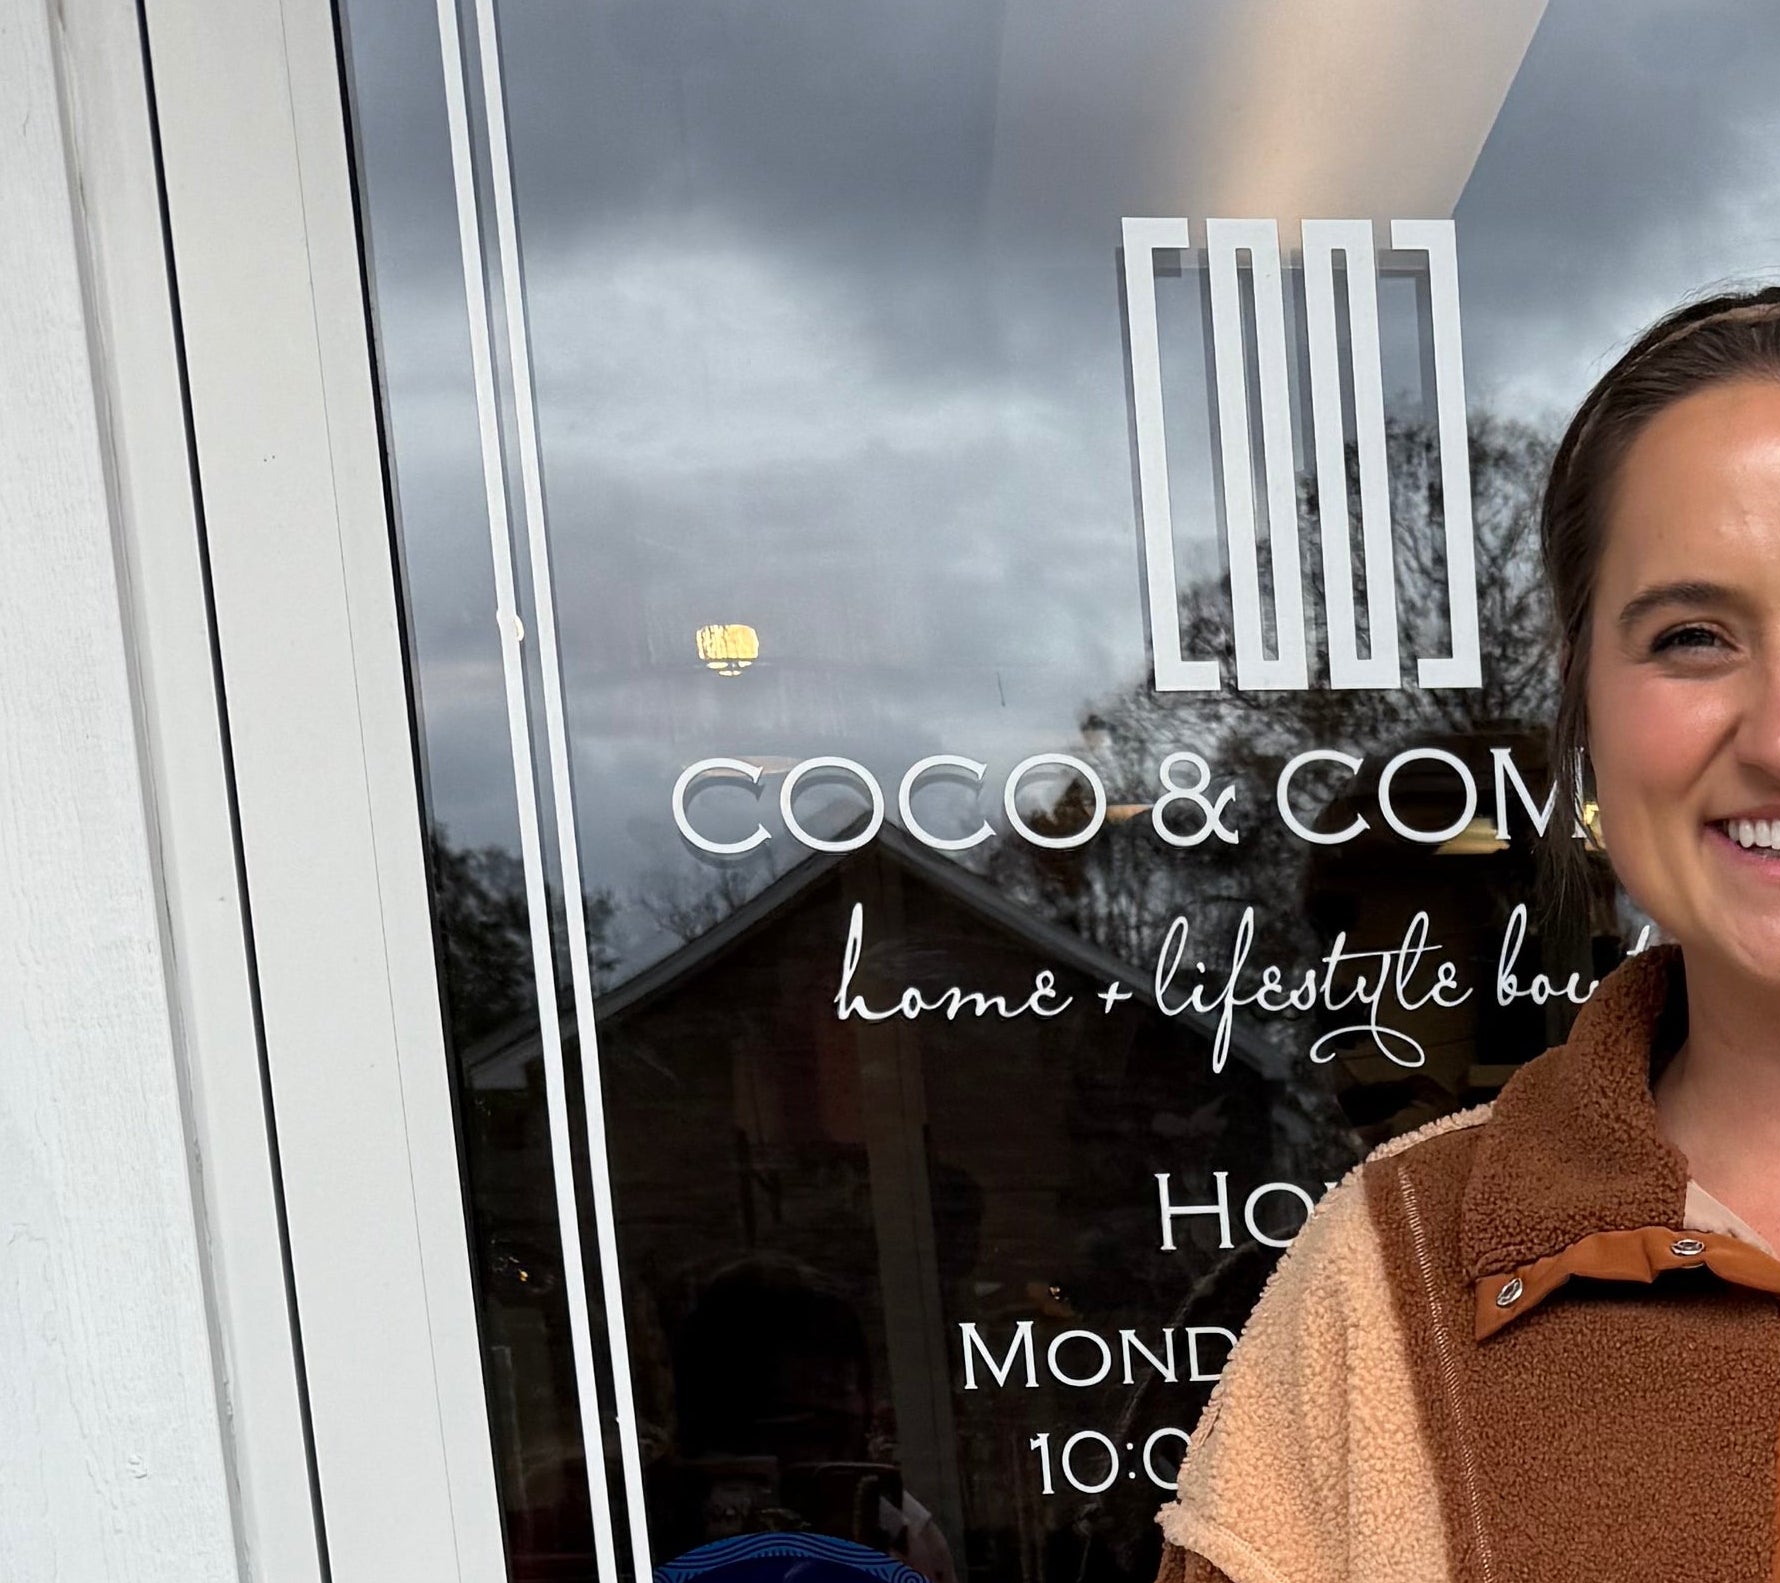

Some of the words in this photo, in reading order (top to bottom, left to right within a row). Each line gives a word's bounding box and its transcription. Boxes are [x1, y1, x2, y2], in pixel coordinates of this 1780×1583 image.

[672, 753, 1107, 855] COCO
[1152, 752, 1239, 847] &
[834, 902, 1073, 1021] home
[1098, 981, 1133, 1014] +
[1154, 905, 1474, 1075] lifestyle
[1497, 902, 1651, 1007] bou
[1154, 1171, 1339, 1251] HO
[959, 1320, 1239, 1390] MOND
